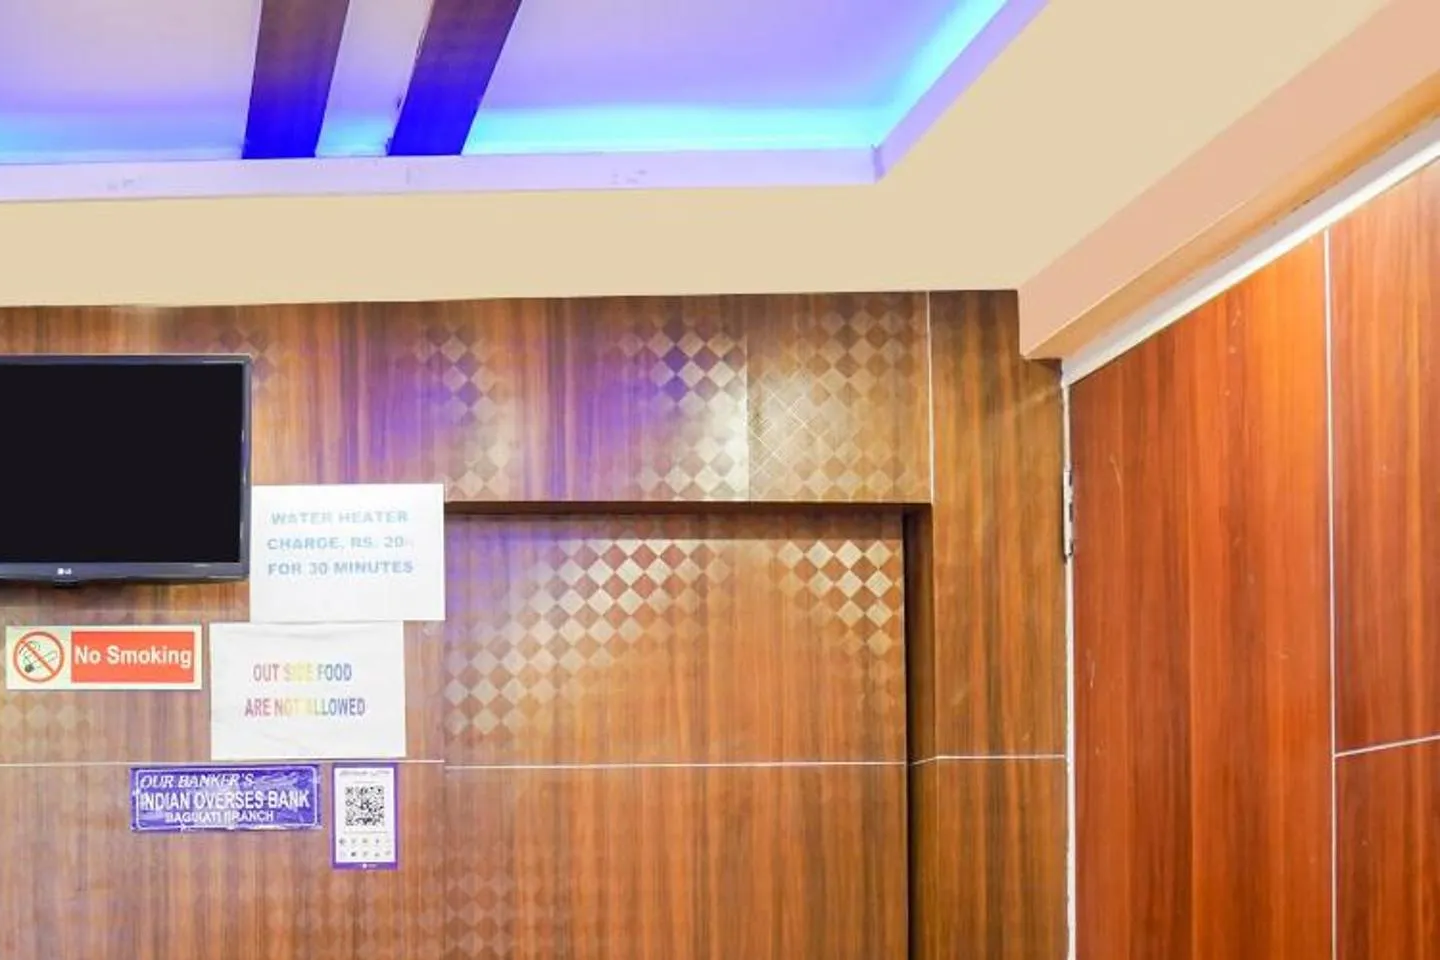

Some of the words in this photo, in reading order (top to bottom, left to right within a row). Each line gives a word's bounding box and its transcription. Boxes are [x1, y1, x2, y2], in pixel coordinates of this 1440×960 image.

[271, 511, 332, 525] WATER
[338, 510, 408, 524] HEATER
[267, 561, 302, 576] FOR
[308, 561, 328, 576] 30
[333, 559, 414, 575] MINUTES
[74, 645, 101, 665] No
[107, 644, 192, 669] Smoking
[252, 663, 280, 682] OUT
[317, 662, 353, 682] FOOD
[244, 698, 272, 717] ARE
[274, 698, 300, 717] NOT
[139, 774, 174, 789] OUR
[140, 792, 190, 811] INDIAN
[193, 791, 264, 809] OVERSES
[268, 790, 310, 809] BANK
